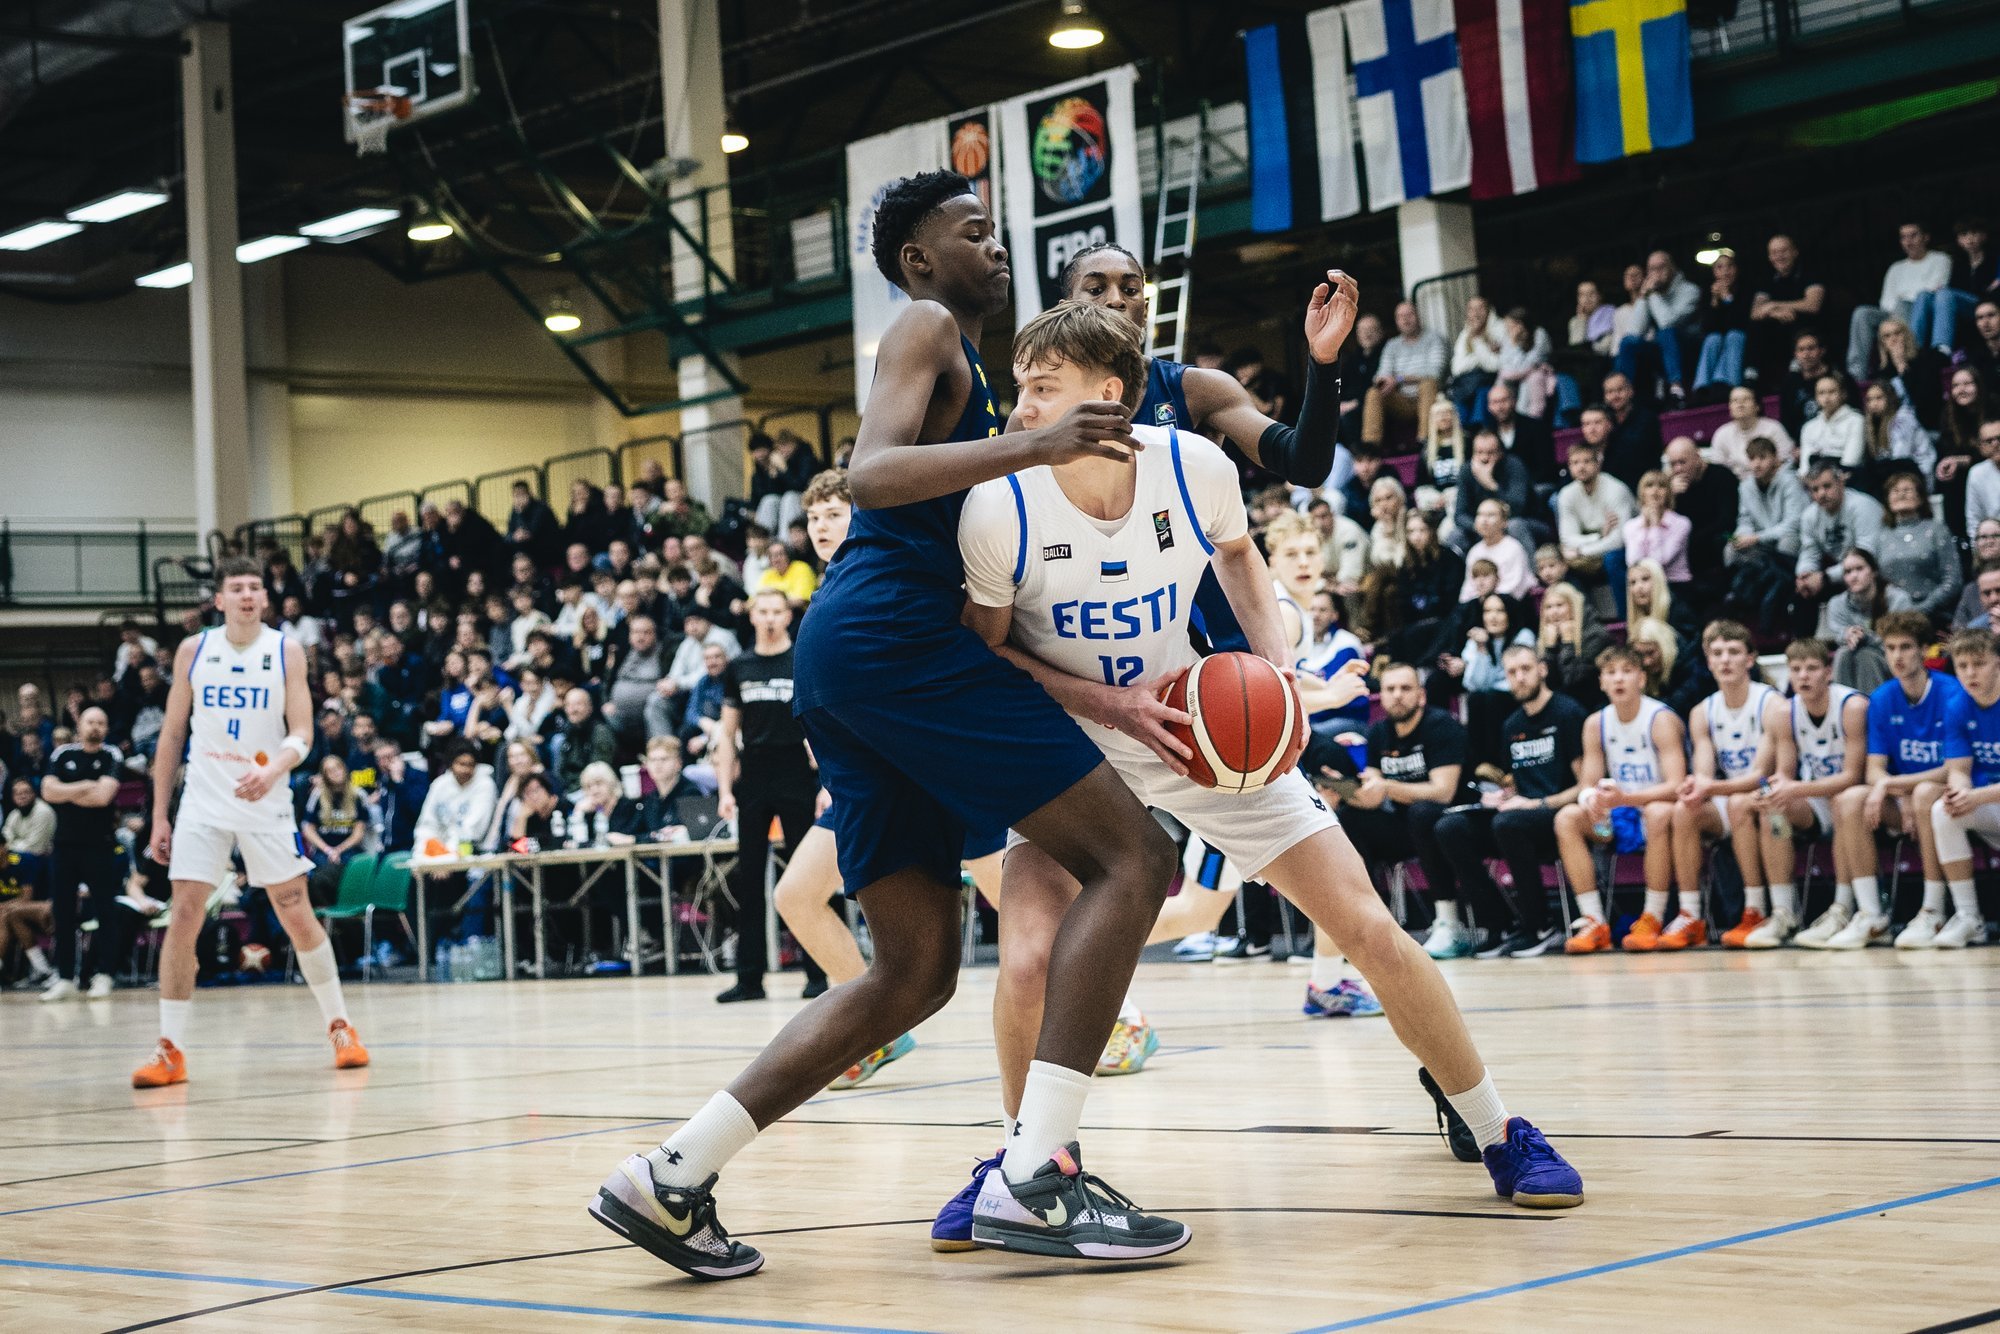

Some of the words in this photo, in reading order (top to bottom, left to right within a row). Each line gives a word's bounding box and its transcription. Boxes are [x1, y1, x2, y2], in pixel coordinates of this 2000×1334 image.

[1044, 546, 1069, 559] BALLZY
[1051, 582, 1177, 640] EESTI
[1098, 655, 1145, 688] 12
[203, 685, 270, 710] EESTI
[227, 718, 241, 741] 4
